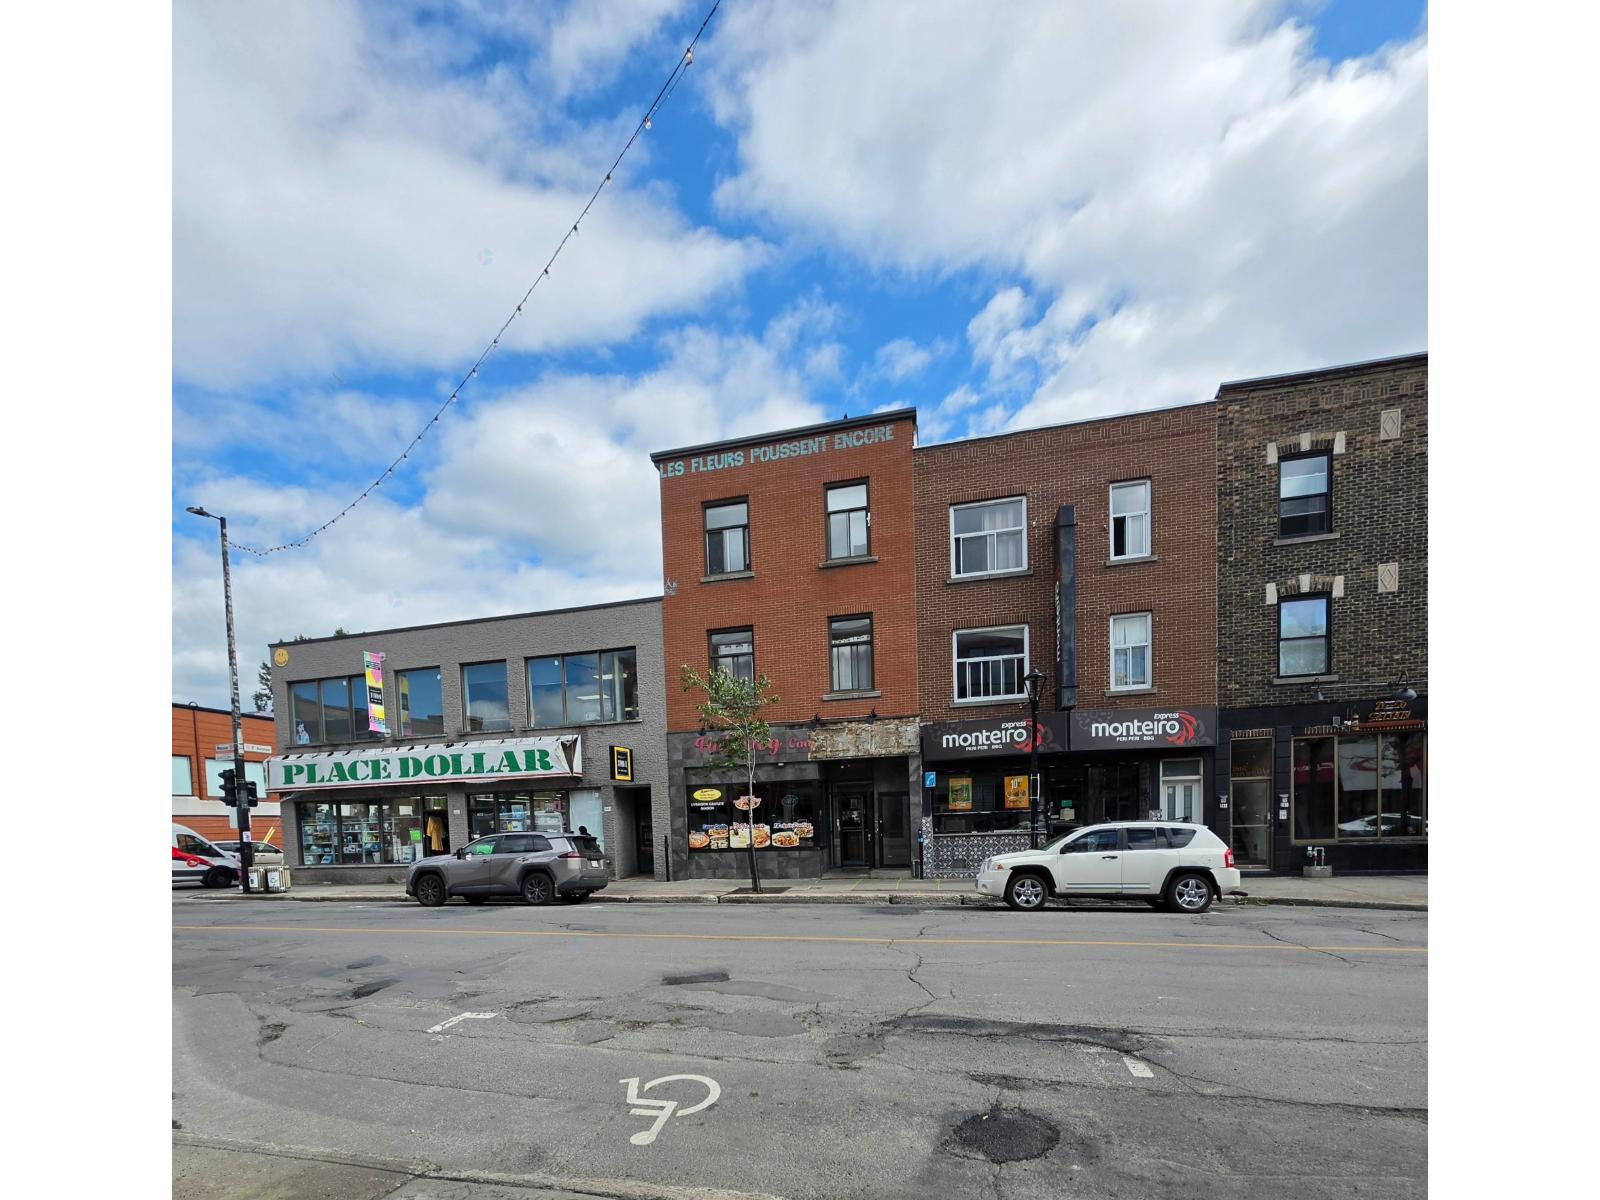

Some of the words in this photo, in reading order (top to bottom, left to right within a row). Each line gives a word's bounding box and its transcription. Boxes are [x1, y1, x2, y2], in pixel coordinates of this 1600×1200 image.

[660, 461, 684, 480] LES
[691, 451, 745, 473] FLEURS
[750, 436, 829, 464] POUSSENT
[834, 424, 895, 450] ENCORE
[1001, 720, 1027, 729] Express
[1154, 712, 1180, 720] Express
[1091, 719, 1180, 737] monteiro
[942, 728, 1028, 748] monteiro
[282, 756, 392, 785] PLACE
[398, 749, 554, 778] DOLLAR
